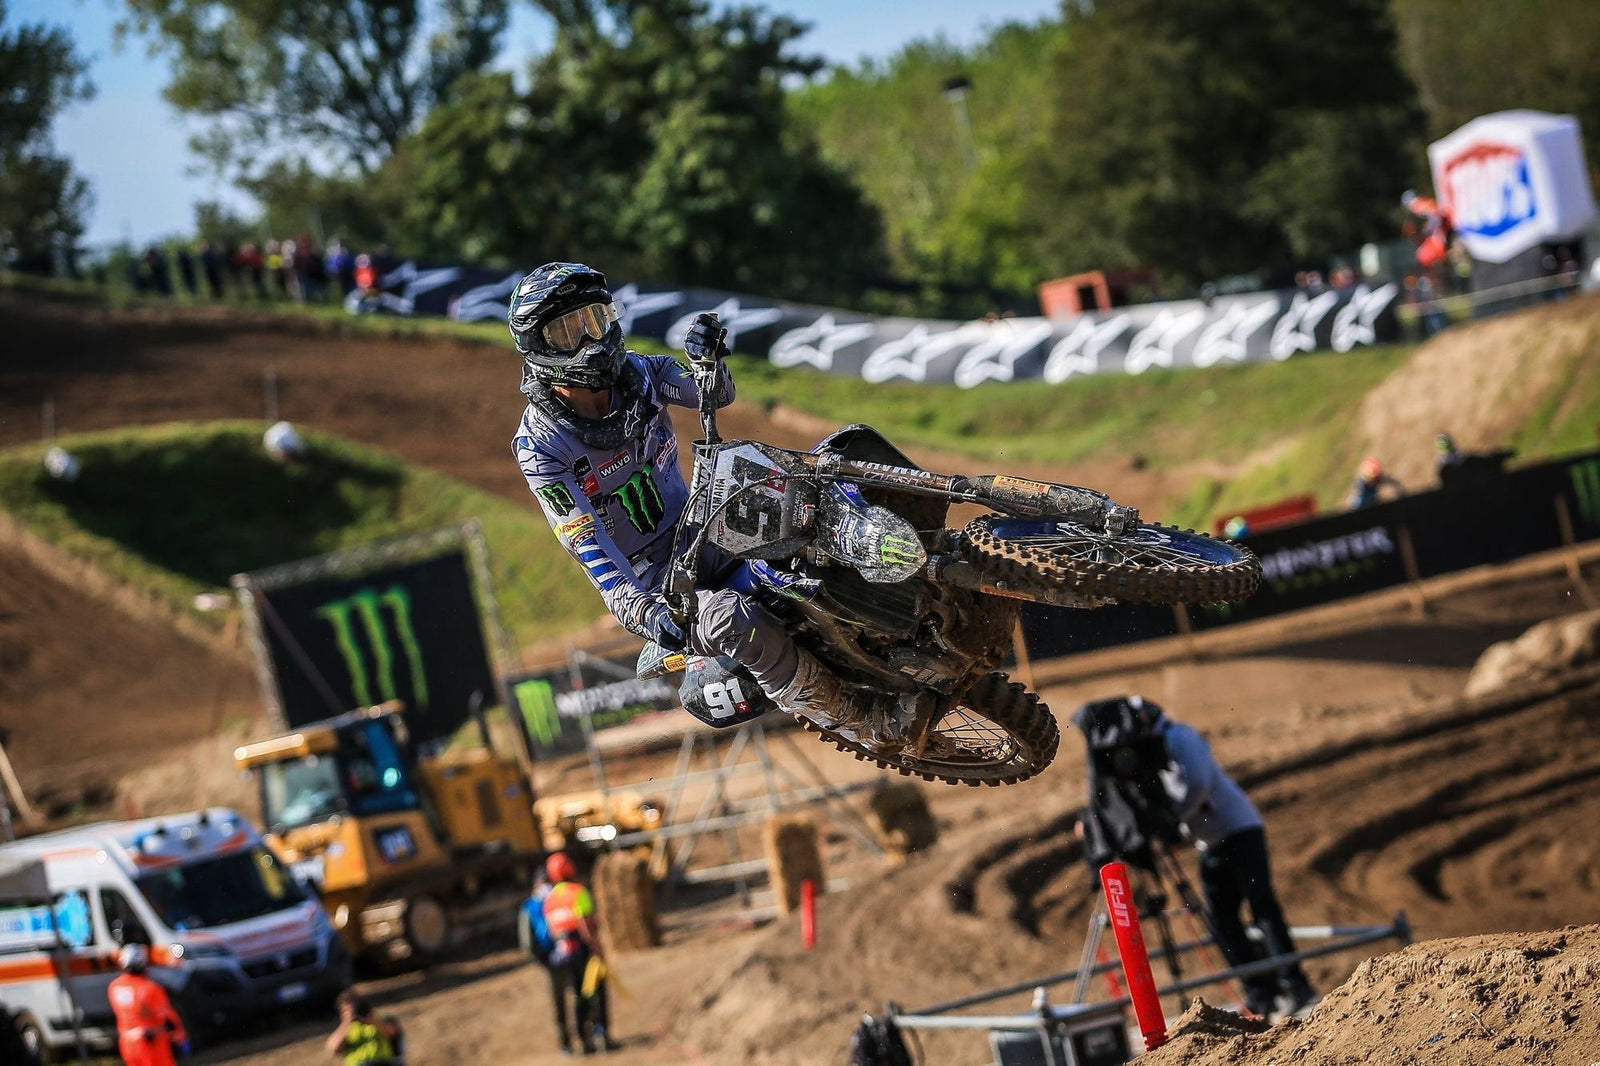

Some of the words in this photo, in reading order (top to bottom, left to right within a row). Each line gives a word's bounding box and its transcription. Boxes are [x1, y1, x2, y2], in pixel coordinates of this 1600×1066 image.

[601, 455, 631, 477] WILVO
[666, 658, 685, 670] PIRELLI
[703, 678, 745, 719] 91
[1108, 878, 1130, 927] UFO
